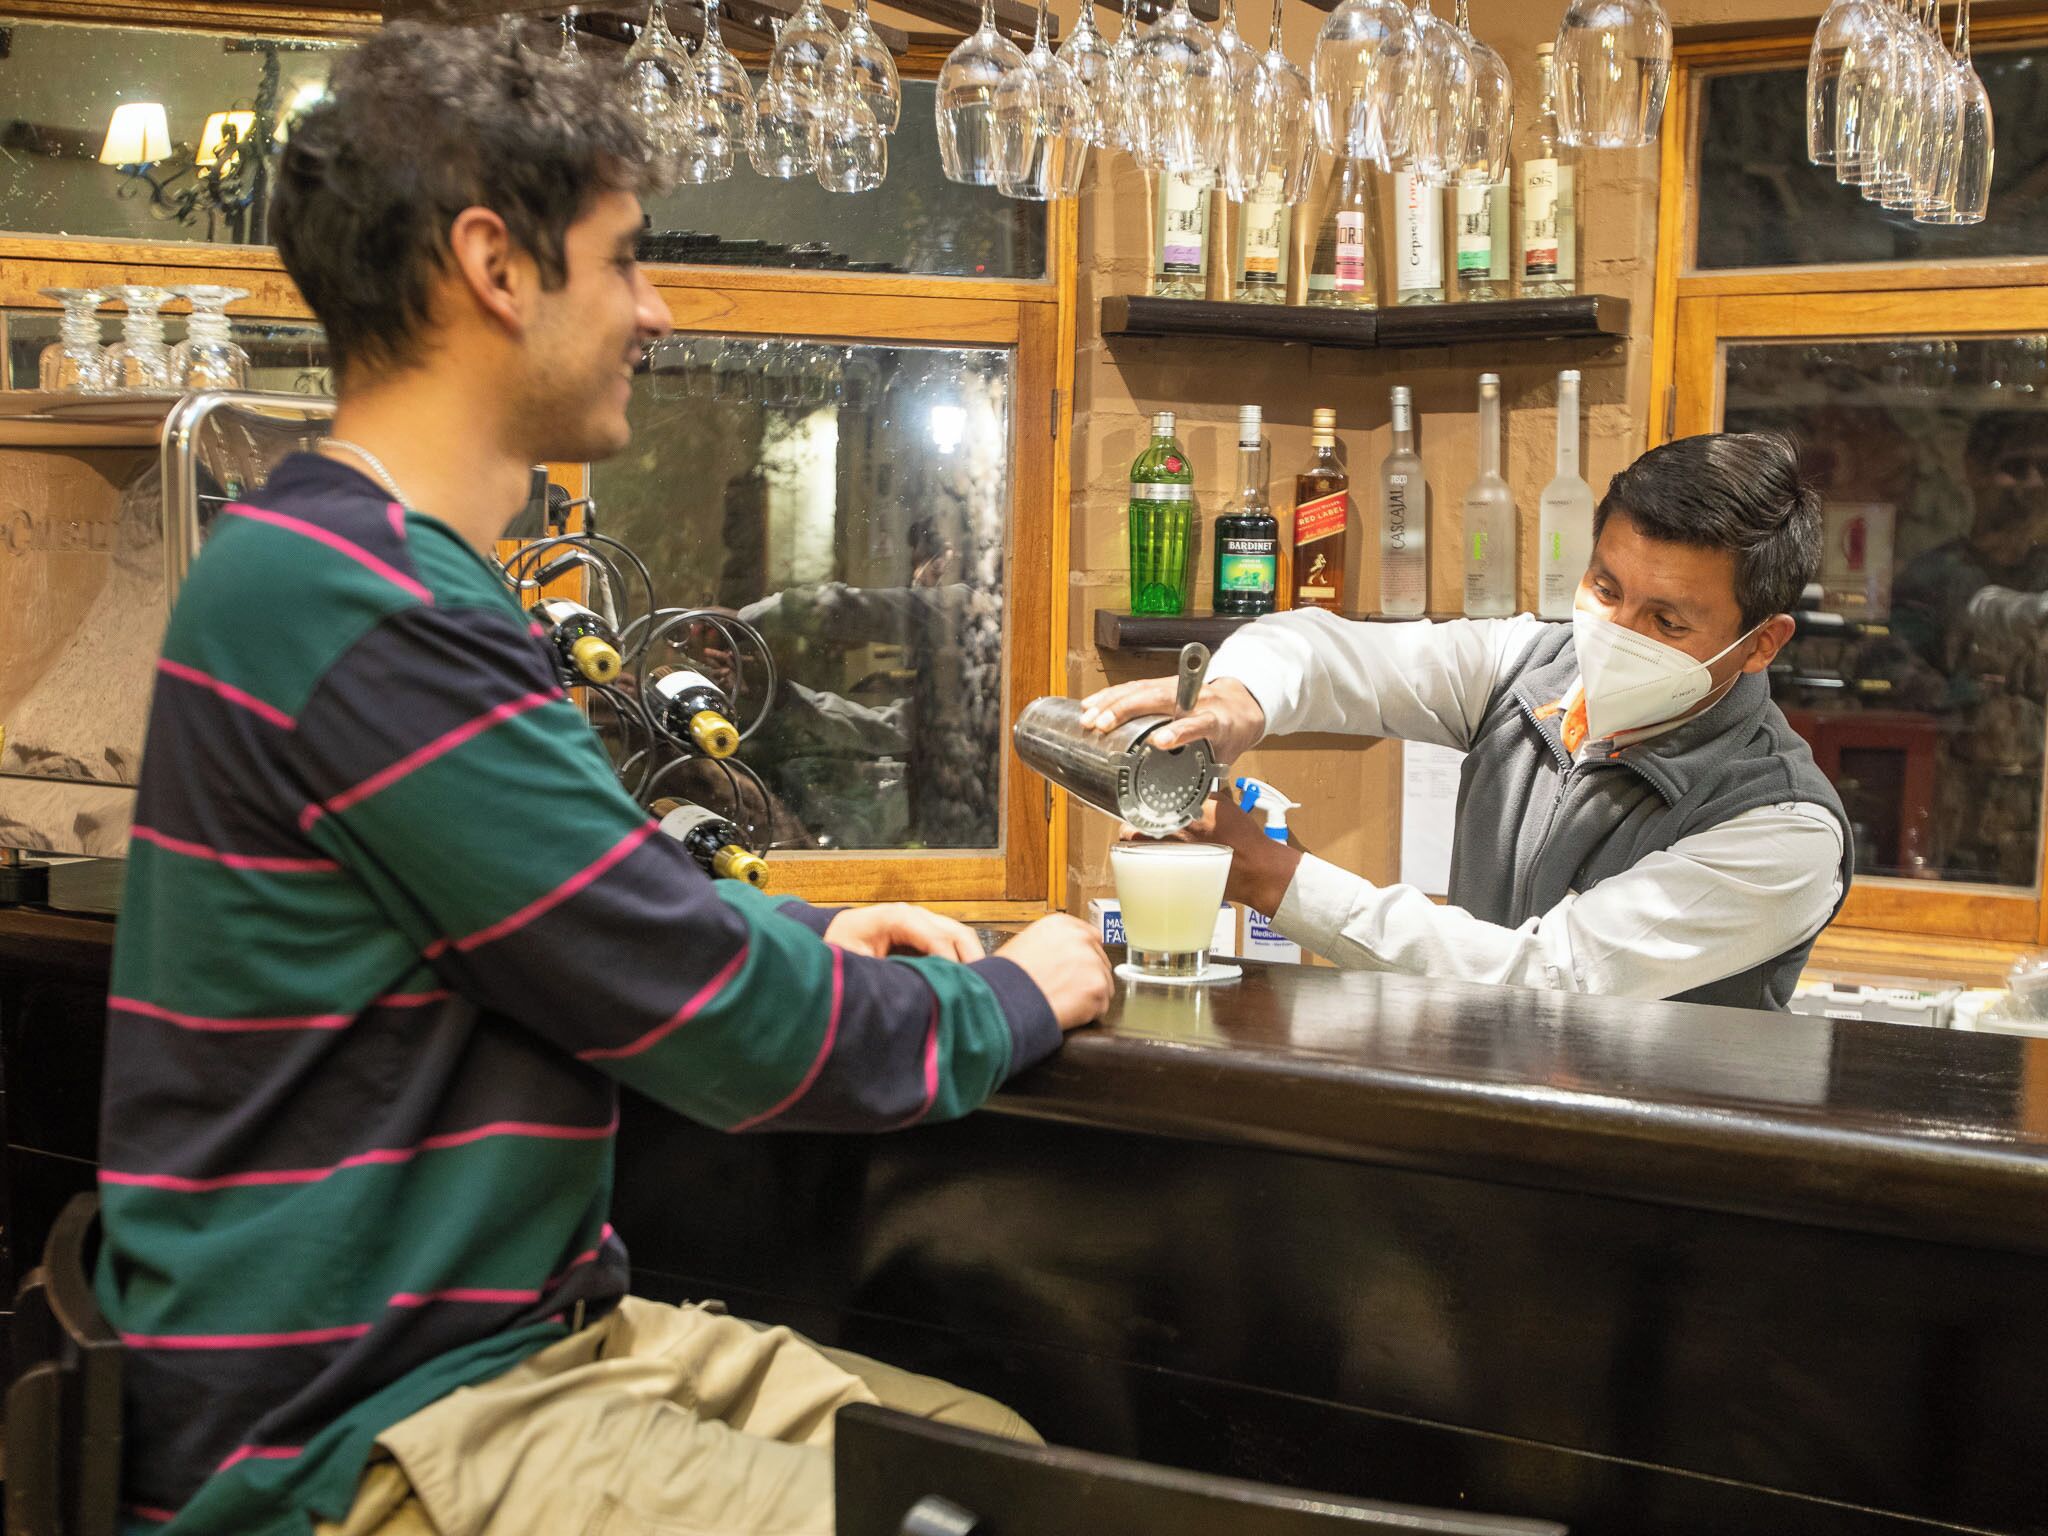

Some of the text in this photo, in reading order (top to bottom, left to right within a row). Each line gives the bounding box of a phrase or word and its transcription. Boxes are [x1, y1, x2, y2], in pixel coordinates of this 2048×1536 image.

[1298, 506, 1345, 526] RED LABEL
[1228, 541, 1273, 551] BARDINET
